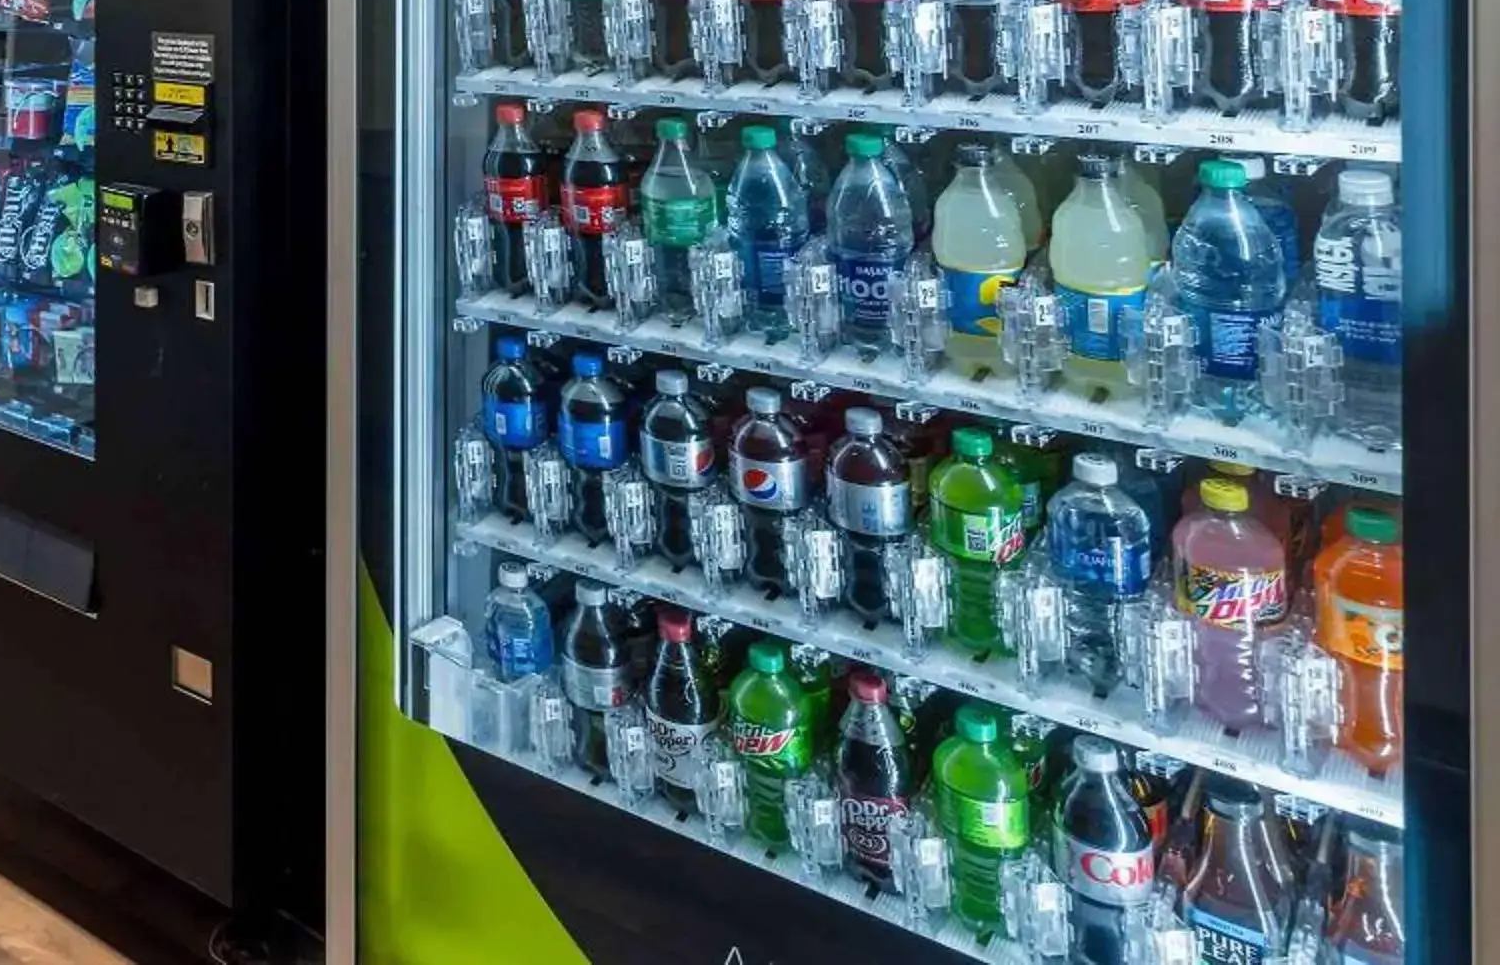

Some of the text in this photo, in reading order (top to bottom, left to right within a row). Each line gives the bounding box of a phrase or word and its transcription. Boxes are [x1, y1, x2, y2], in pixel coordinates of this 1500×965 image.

[847, 108, 867, 119] 205
[958, 117, 980, 129] 206
[1076, 123, 1100, 135] 207
[1208, 133, 1234, 146] 208
[1081, 421, 1105, 436] 307
[1211, 444, 1238, 460] 308
[1196, 924, 1258, 957] PURE
